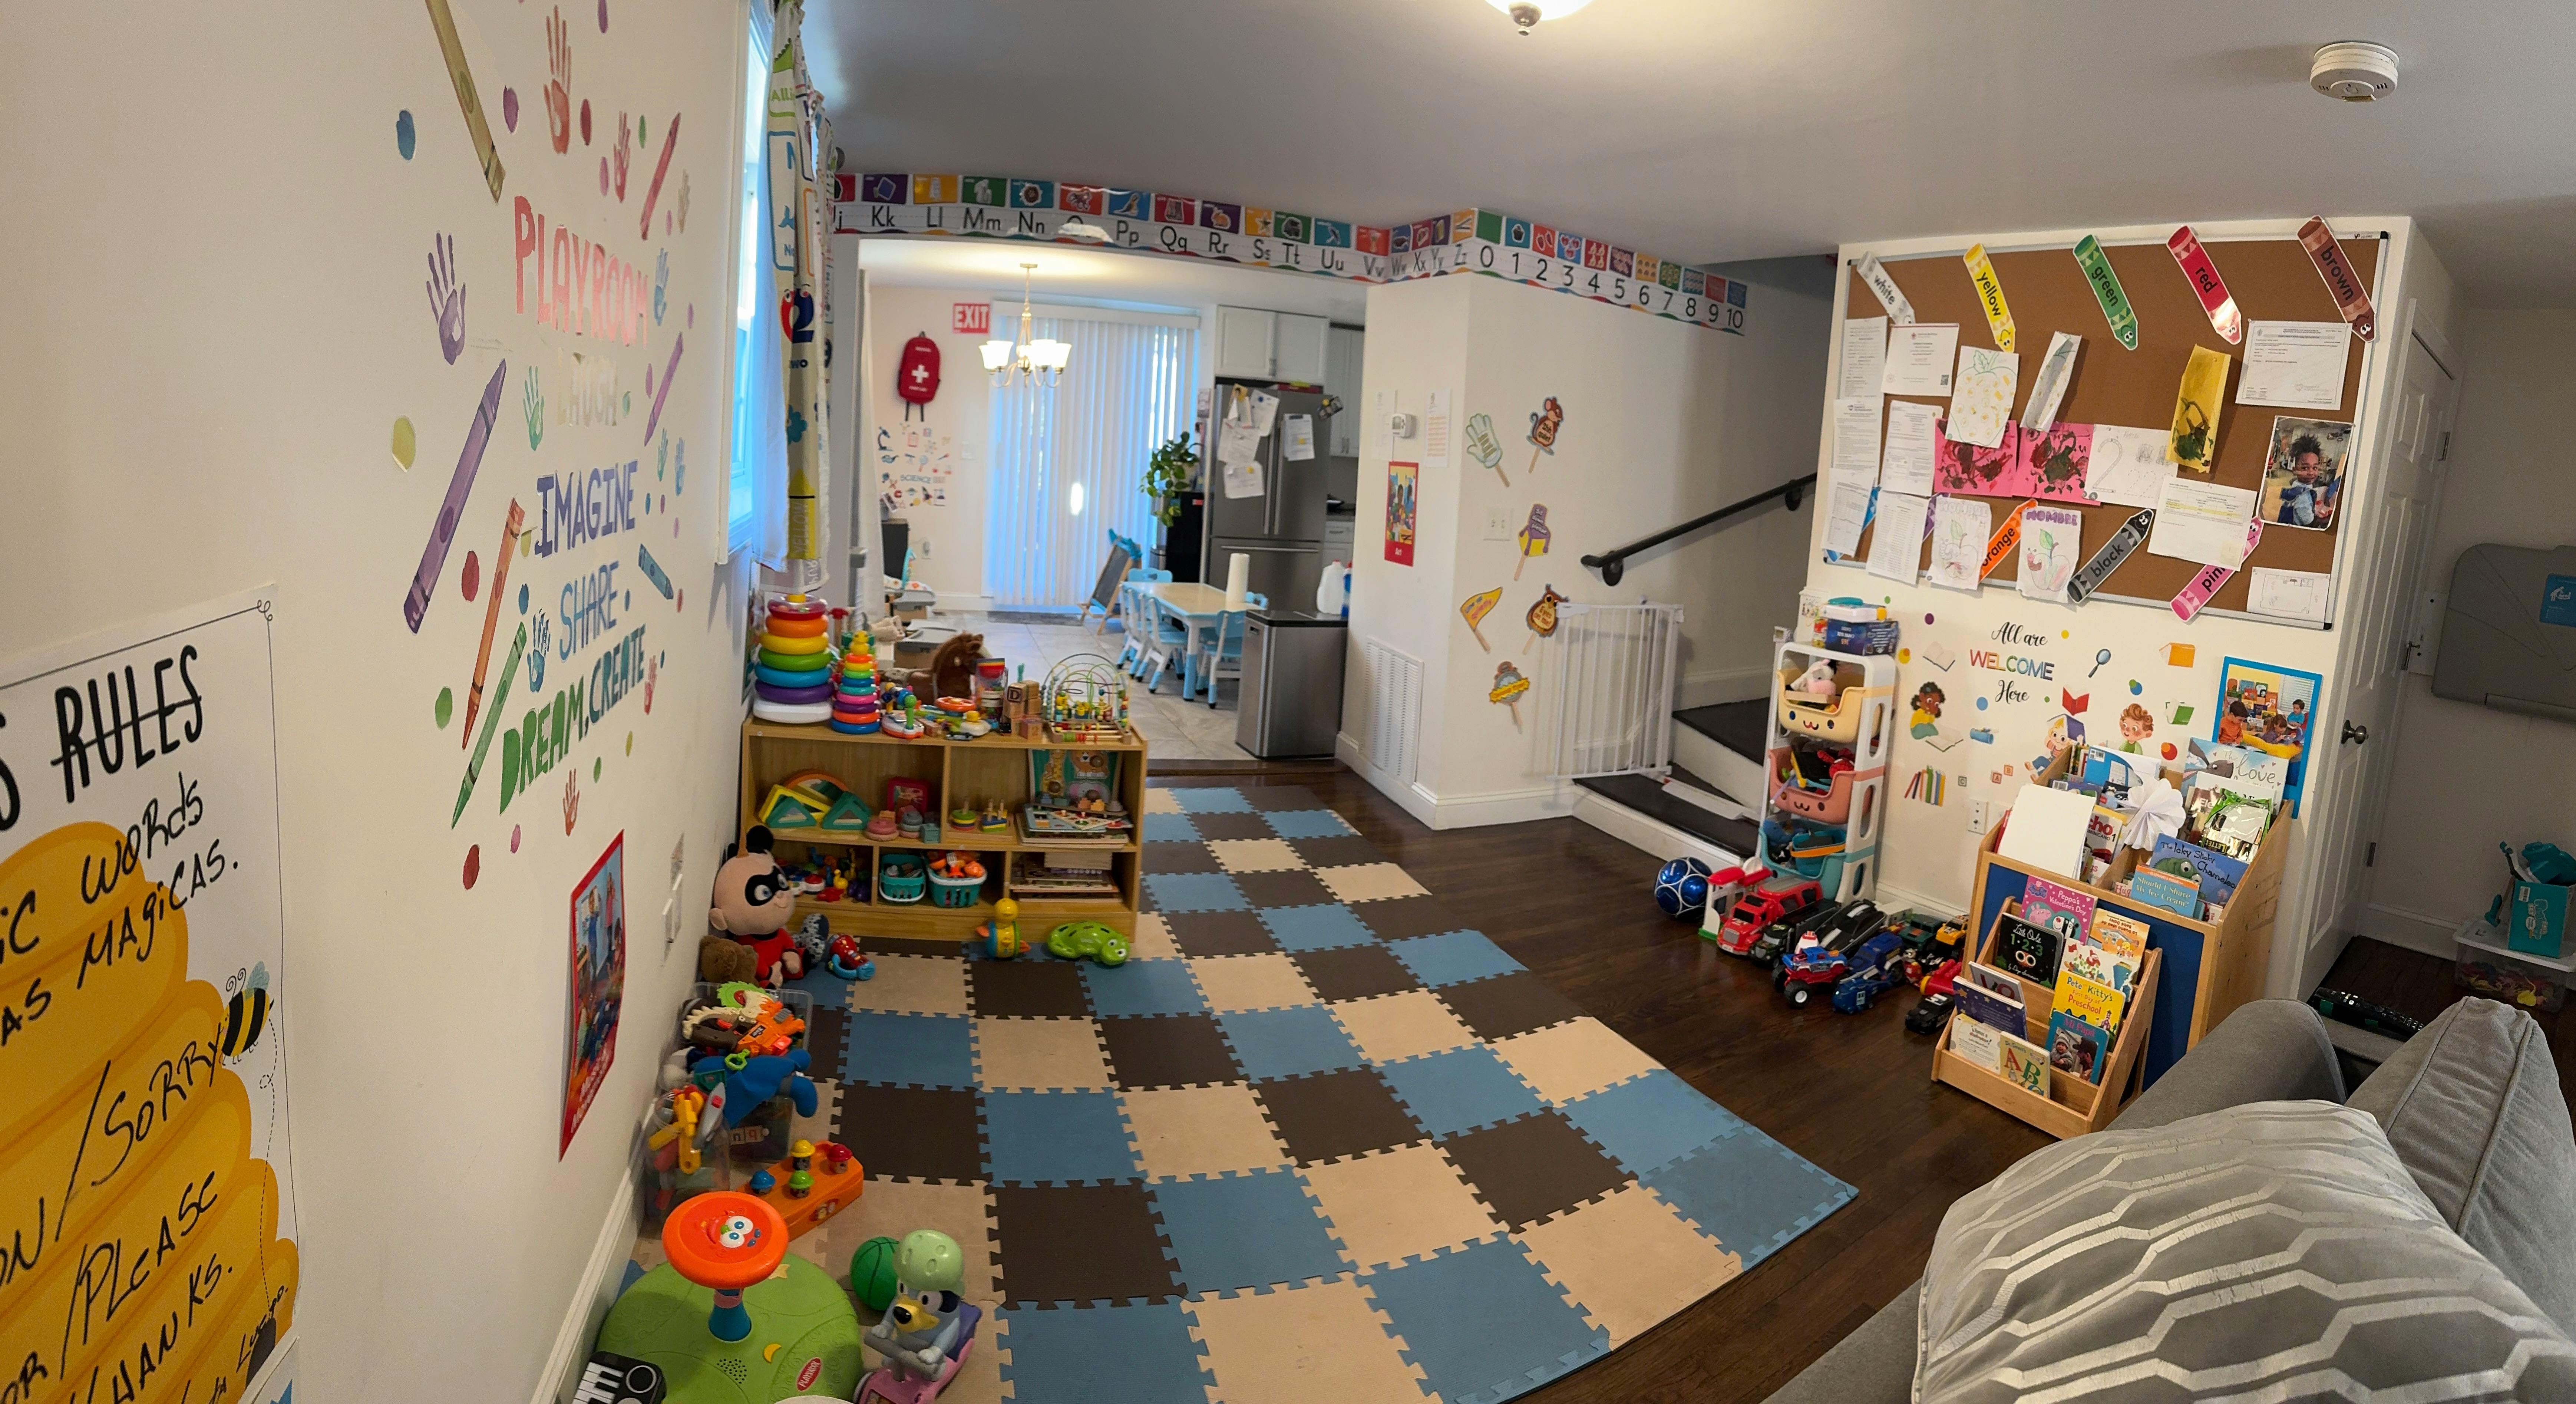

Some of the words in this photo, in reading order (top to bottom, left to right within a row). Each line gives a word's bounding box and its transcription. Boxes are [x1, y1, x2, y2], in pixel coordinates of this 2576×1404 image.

[871, 205, 895, 227] Kk
[926, 206, 942, 228] Ll
[963, 207, 1001, 231] Mm
[1018, 210, 1044, 234] Nn
[1115, 220, 1140, 246] Pp
[1160, 226, 1188, 252] Qq
[1209, 232, 1229, 254] Rr
[1282, 243, 1300, 265] Tt
[1321, 249, 1344, 271] Uu
[1364, 255, 1385, 277] Vv
[514, 195, 648, 349] PLAYROOM
[2195, 266, 2218, 294] red
[2320, 245, 2354, 301] brown
[1512, 252, 1519, 274] 1
[1536, 258, 1548, 281] 2
[1562, 265, 1573, 286] 3
[1588, 273, 1600, 293] 4
[1614, 279, 1625, 299] 5
[1639, 285, 1649, 305] 6
[1663, 291, 1674, 310] 7
[1686, 297, 1697, 317] 8
[1708, 303, 1719, 323] 9
[1726, 309, 1743, 328] 10
[1874, 275, 1895, 305] white
[1976, 271, 2001, 317] yellow
[2091, 266, 2119, 307] green
[954, 305, 988, 328] EXIT
[534, 460, 638, 558] IMAGINE
[2090, 543, 2124, 578] black
[2201, 565, 2226, 592] pin
[559, 560, 620, 663] SHARE
[1991, 621, 2024, 645] All
[2024, 634, 2048, 647] are
[1969, 649, 2055, 681] WELCOME
[1010, 689, 1020, 699] D
[1995, 679, 2030, 705] Here
[55, 645, 202, 804] RULES
[2160, 841, 2173, 850] The
[2174, 842, 2192, 858] Icky
[2194, 850, 2215, 864] Sticky
[2137, 876, 2162, 890] Should
[2169, 885, 2191, 899] Share
[2197, 861, 2236, 890] Chameleo
[2049, 896, 2074, 912] Valentine's
[2075, 905, 2087, 916] Day
[2057, 890, 2080, 905] Peppa's
[2136, 884, 2146, 895] My
[2148, 888, 2159, 898] Ice
[2160, 891, 2189, 908] Cream?
[2012, 923, 2027, 937] Little
[2027, 929, 2042, 943] Owls
[2067, 976, 2083, 989] Pete
[2088, 985, 2113, 1002] Kitty's
[2084, 995, 2093, 1004] Day
[2068, 994, 2101, 1014] Preschool
[798, 1361, 820, 1387] PLAYSKOOL
